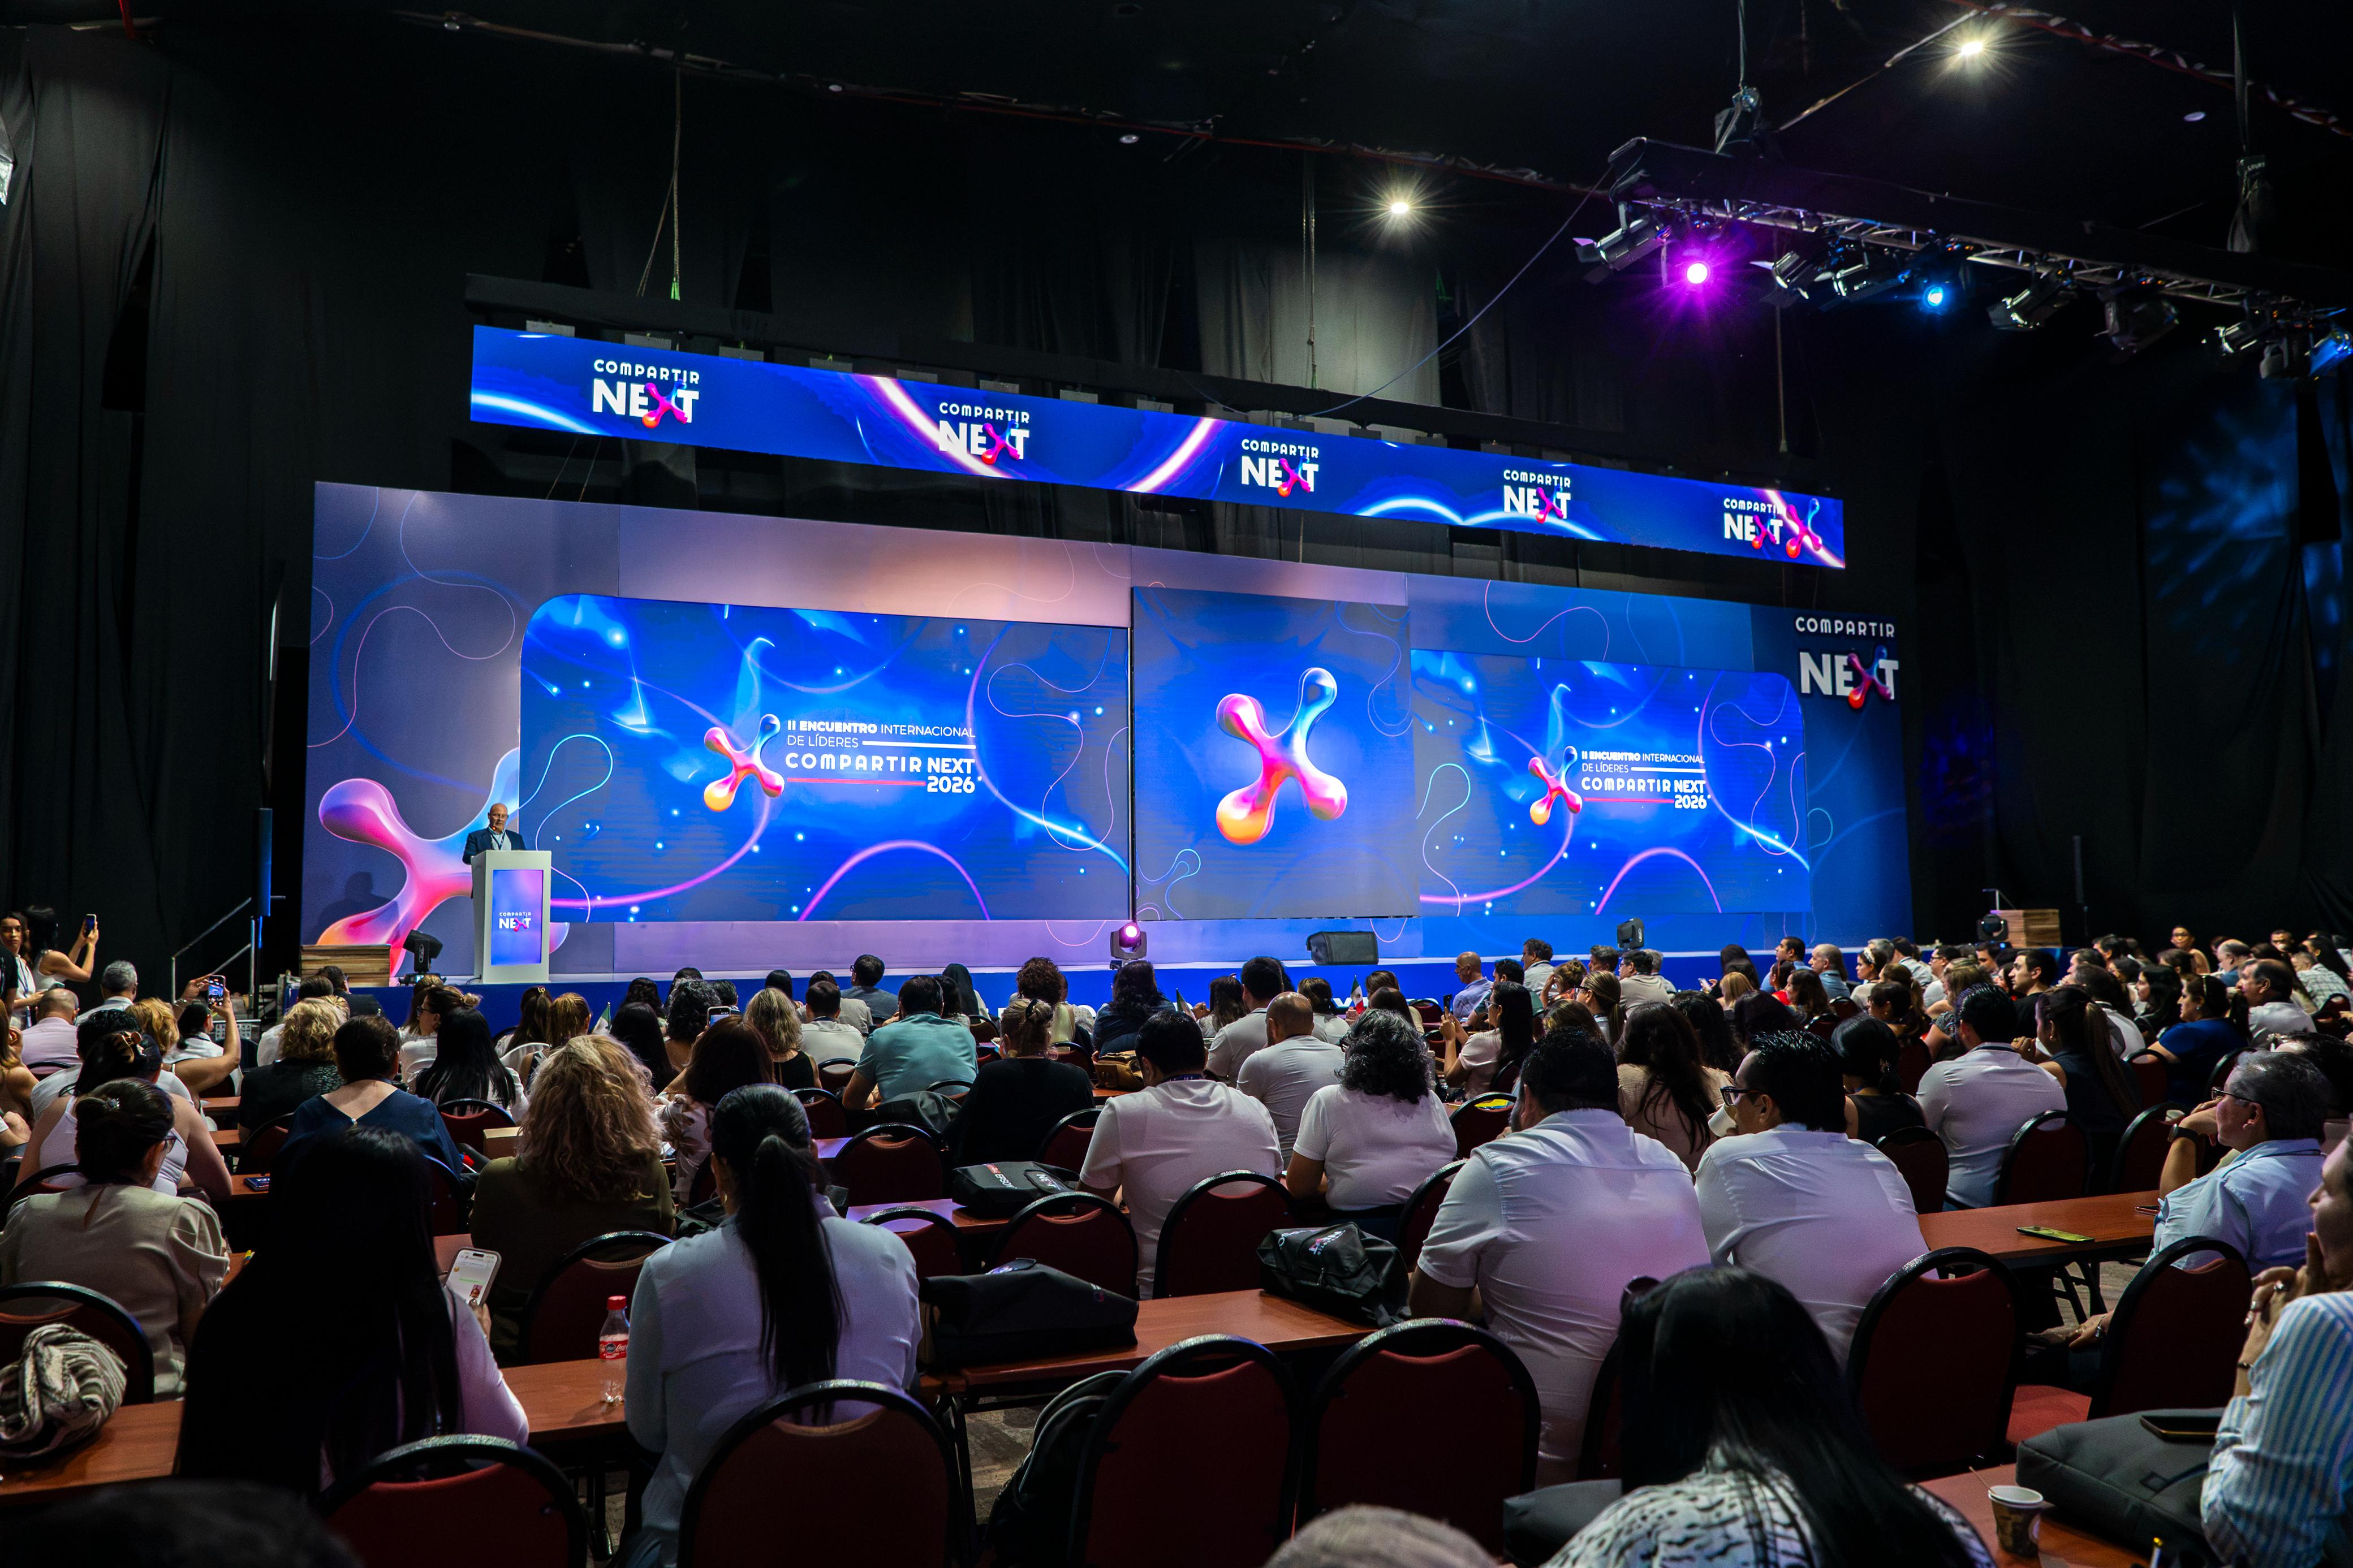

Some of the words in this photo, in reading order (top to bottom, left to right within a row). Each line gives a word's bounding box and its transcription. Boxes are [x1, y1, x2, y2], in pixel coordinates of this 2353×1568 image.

[593, 359, 700, 384] COMPARTIR
[593, 378, 700, 429] NEXT
[939, 402, 1030, 424] COMPARTIR
[938, 420, 1029, 465] NEXT
[1241, 439, 1319, 459] COMPARTIR
[1241, 454, 1319, 498] NEXT
[1503, 469, 1571, 488] COMPARTIR
[1503, 484, 1571, 524] NEXT
[1723, 498, 1782, 515] COMPARTI
[1723, 512, 1783, 549] NEXT
[1795, 616, 1895, 638] COMPARTIR
[1799, 645, 1899, 710] NEXT
[788, 720, 796, 731] II
[799, 720, 878, 734] ENCUENTRO
[881, 723, 976, 738] INTERNACIONAL
[787, 735, 805, 746] DE
[808, 733, 860, 748] LÍDERES
[785, 753, 922, 773] COMPARTIR
[927, 757, 975, 775] NEXT
[1581, 750, 1588, 760] II
[1589, 750, 1641, 762] ENCUENTRO
[1642, 753, 1705, 763] INTERNACIONAL
[1581, 762, 1594, 772] DE
[1596, 761, 1629, 774] LÍDERES
[927, 775, 976, 794] 2026
[1581, 777, 1671, 793] COMPARTIR
[1674, 780, 1706, 793] NEXT
[1674, 794, 1707, 809] 2026
[499, 917, 532, 932] NEXT
